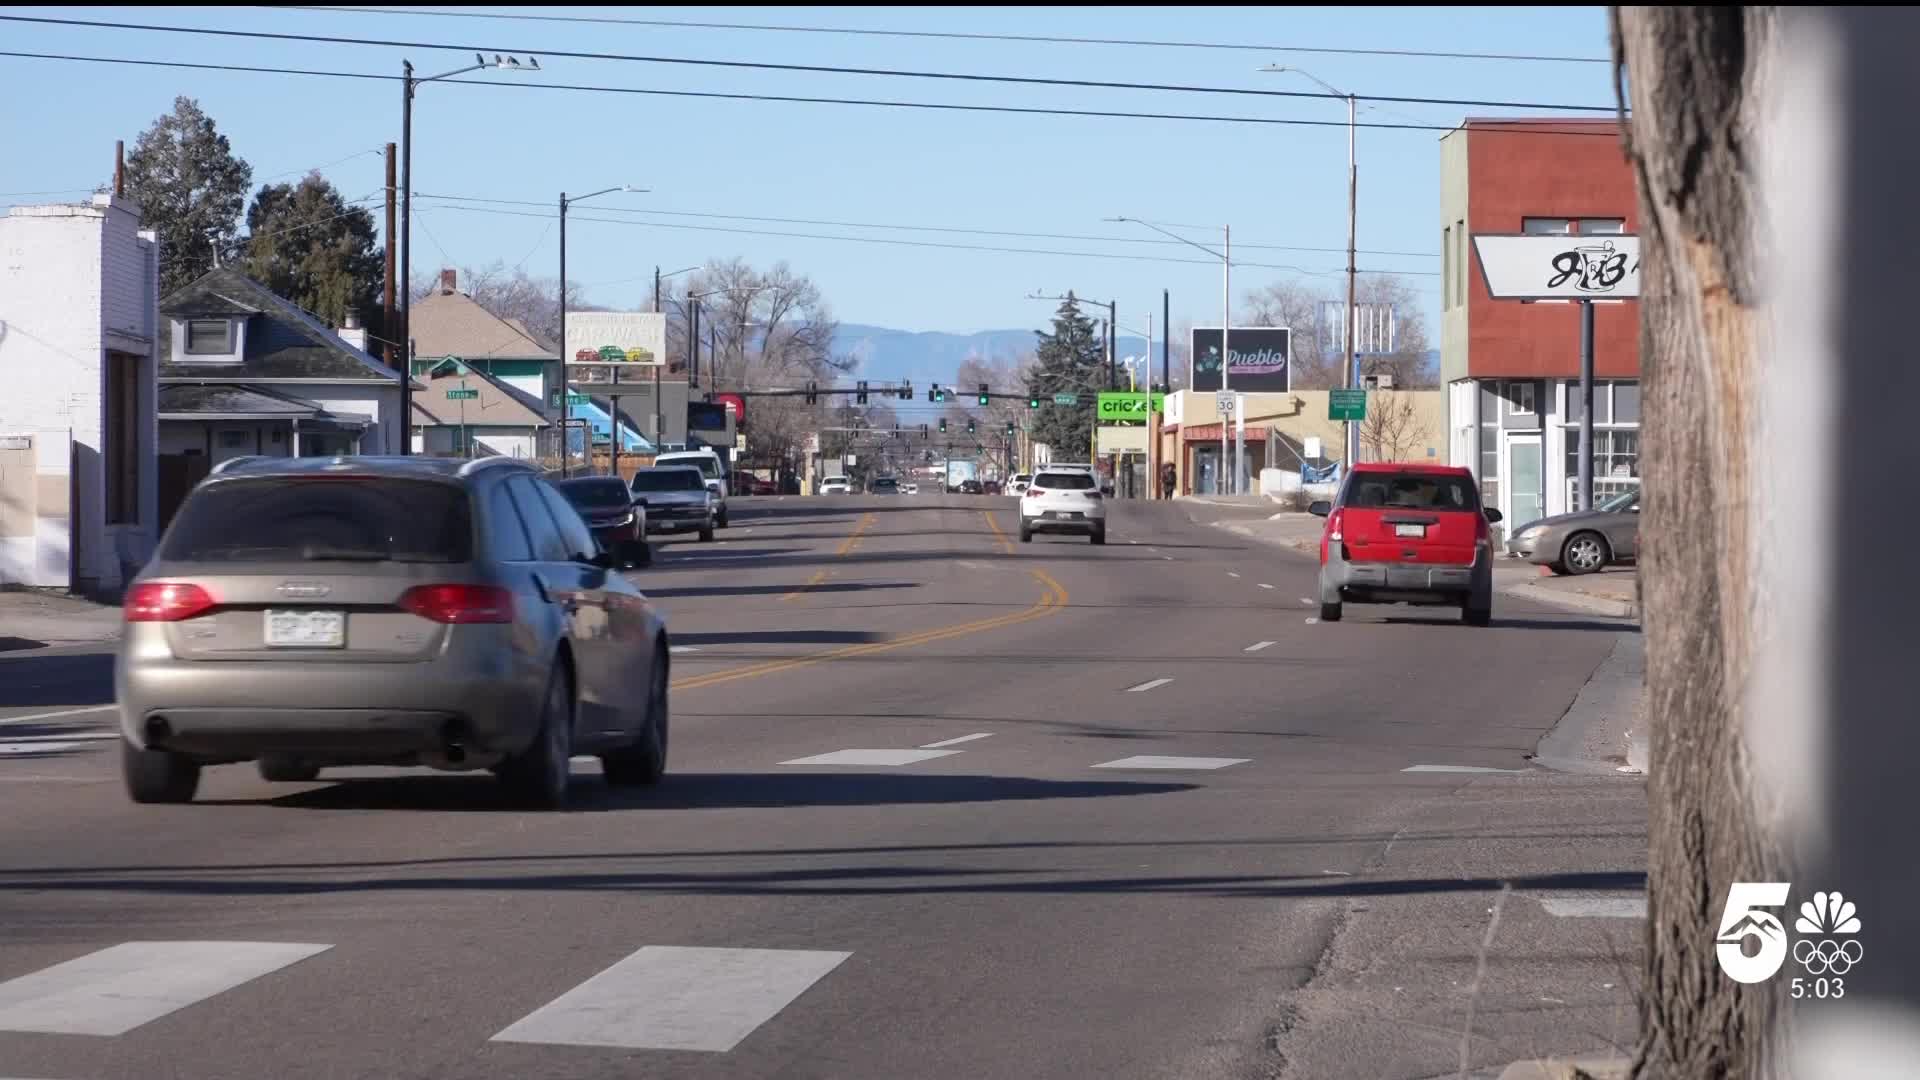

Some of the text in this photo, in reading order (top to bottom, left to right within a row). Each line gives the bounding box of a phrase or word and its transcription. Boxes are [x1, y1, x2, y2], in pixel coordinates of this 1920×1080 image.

[1227, 348, 1284, 366] Pueblo
[1103, 400, 1158, 412] cricket
[1219, 401, 1234, 410] 30
